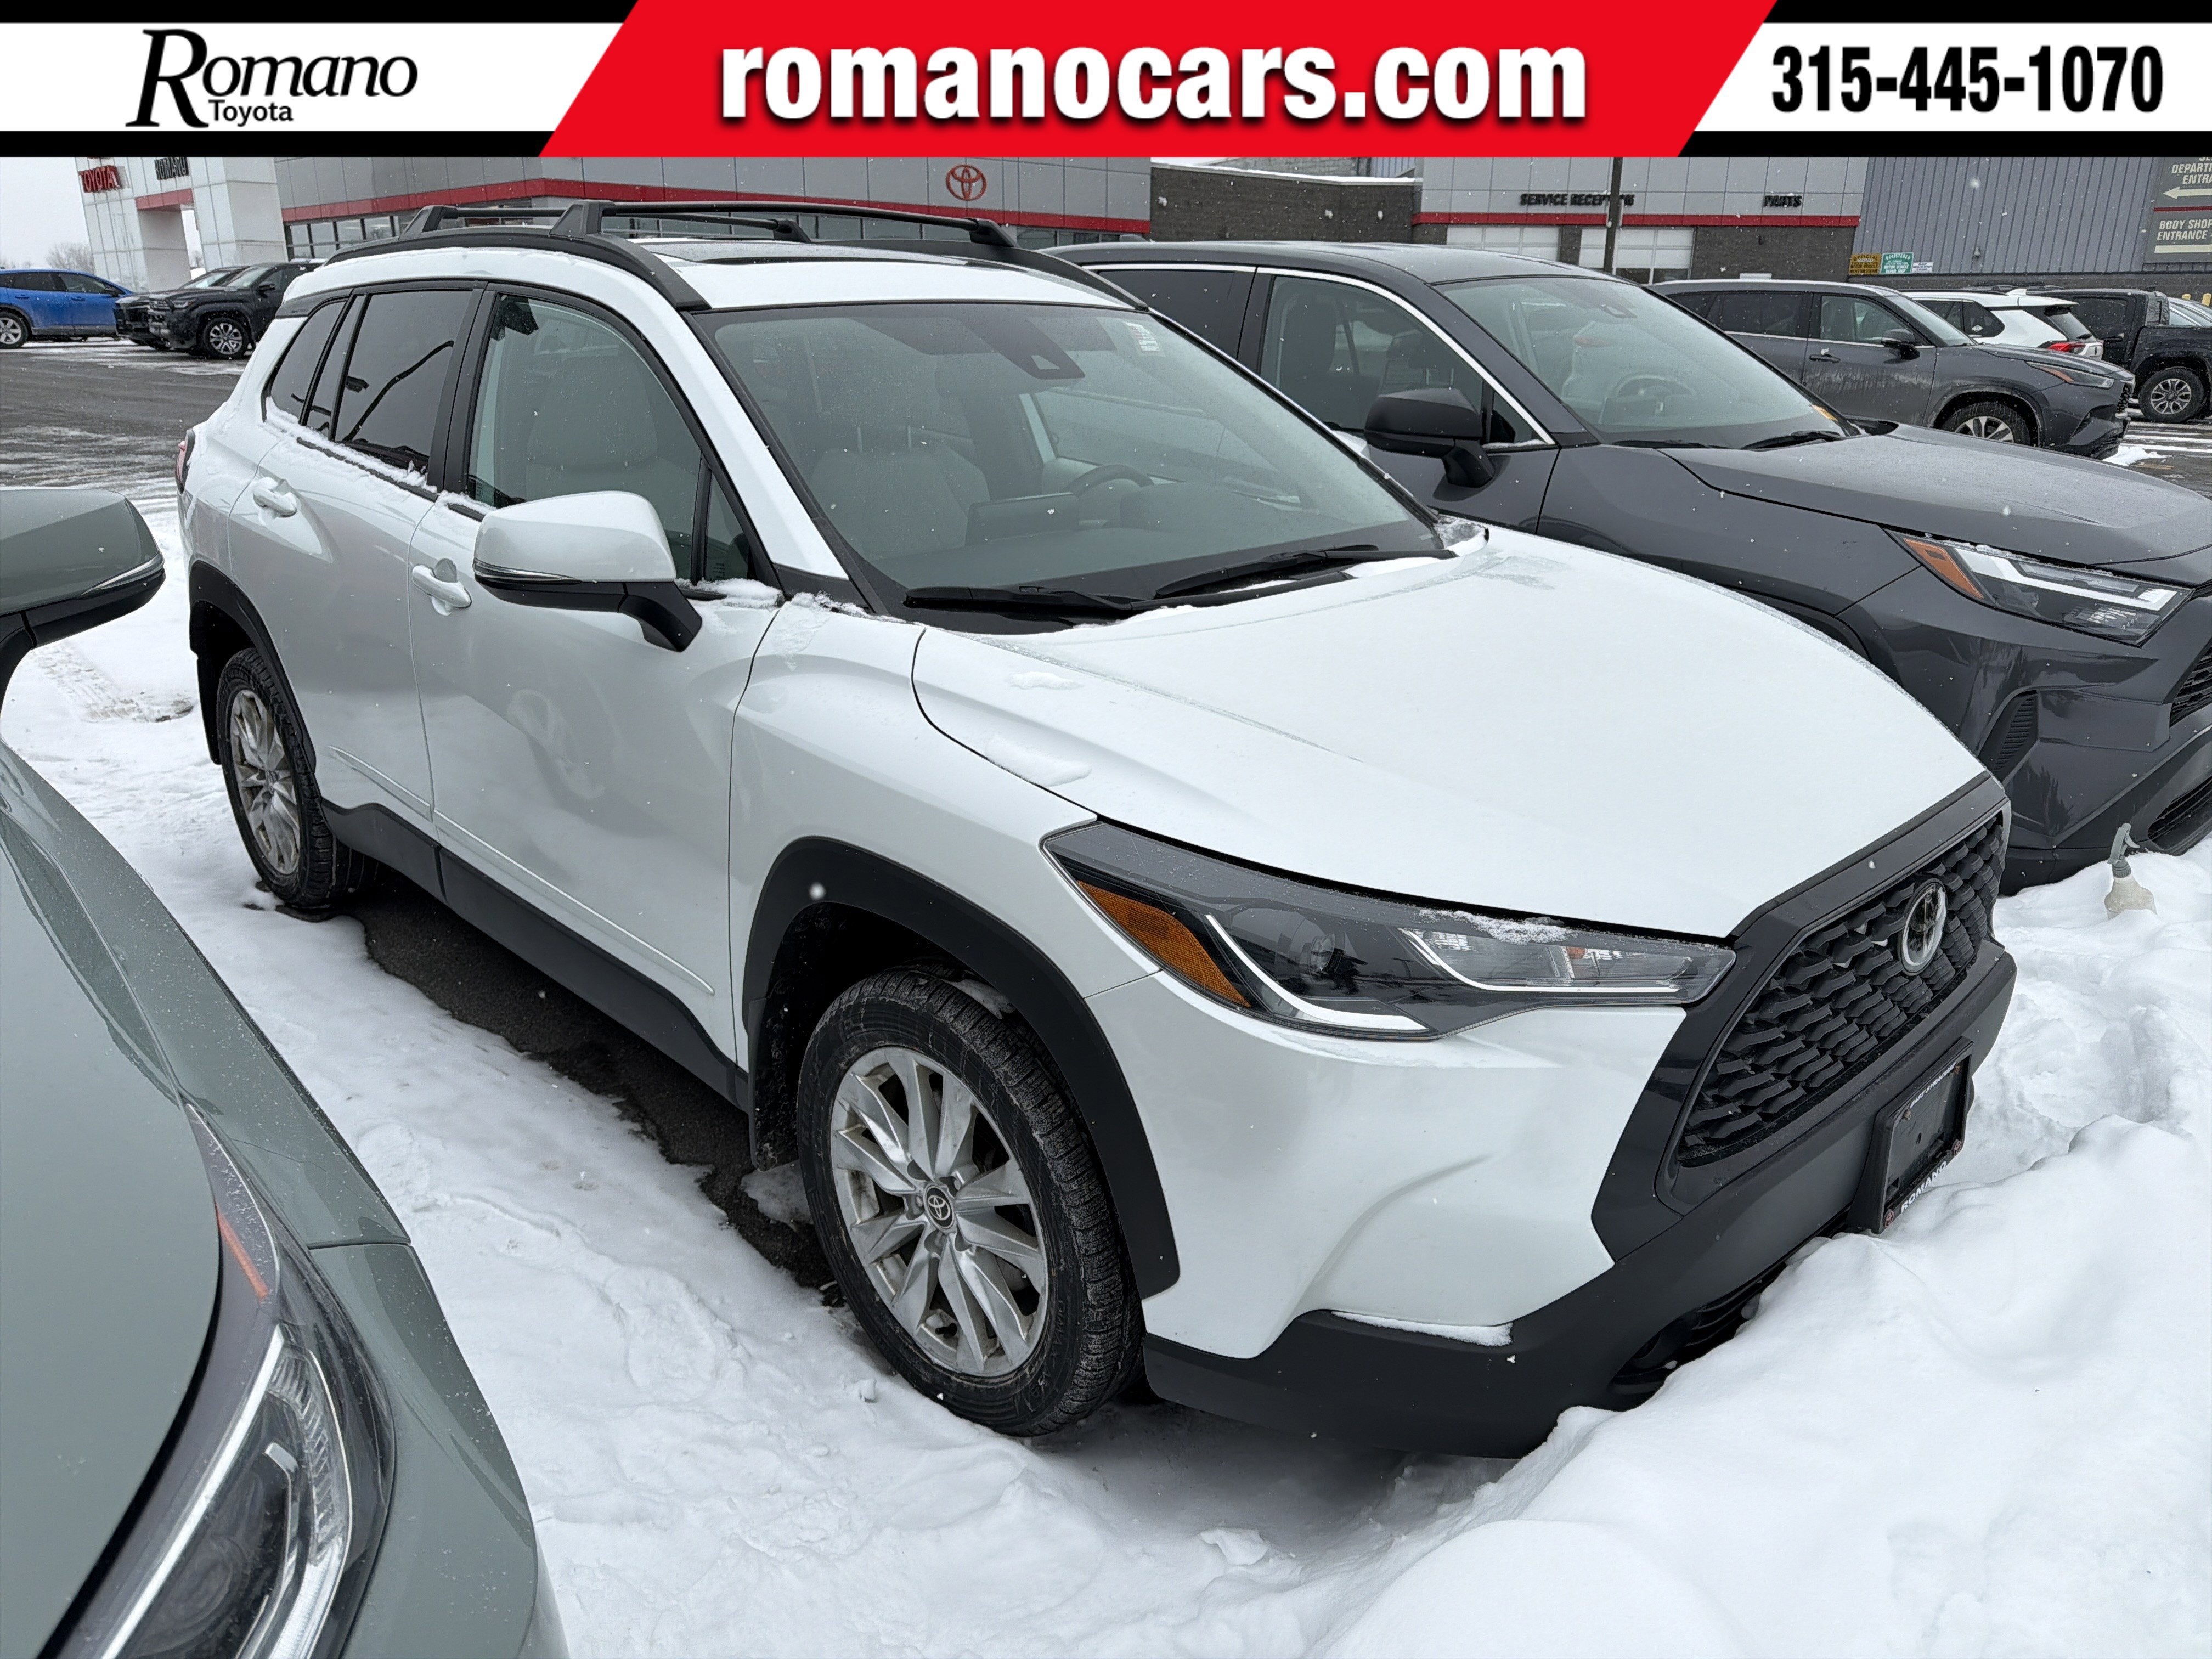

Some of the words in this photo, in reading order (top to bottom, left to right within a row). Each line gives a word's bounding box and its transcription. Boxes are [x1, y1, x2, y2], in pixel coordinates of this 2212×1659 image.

[154, 157, 190, 180] ROMANO
[78, 166, 120, 193] TOYOTA
[1520, 194, 1568, 205] SERVICE
[1764, 195, 1802, 207] PARTS
[2159, 220, 2186, 230] BODY
[2157, 230, 2208, 240] ENTRANCE
[1901, 1161, 1946, 1214] ROMANO
